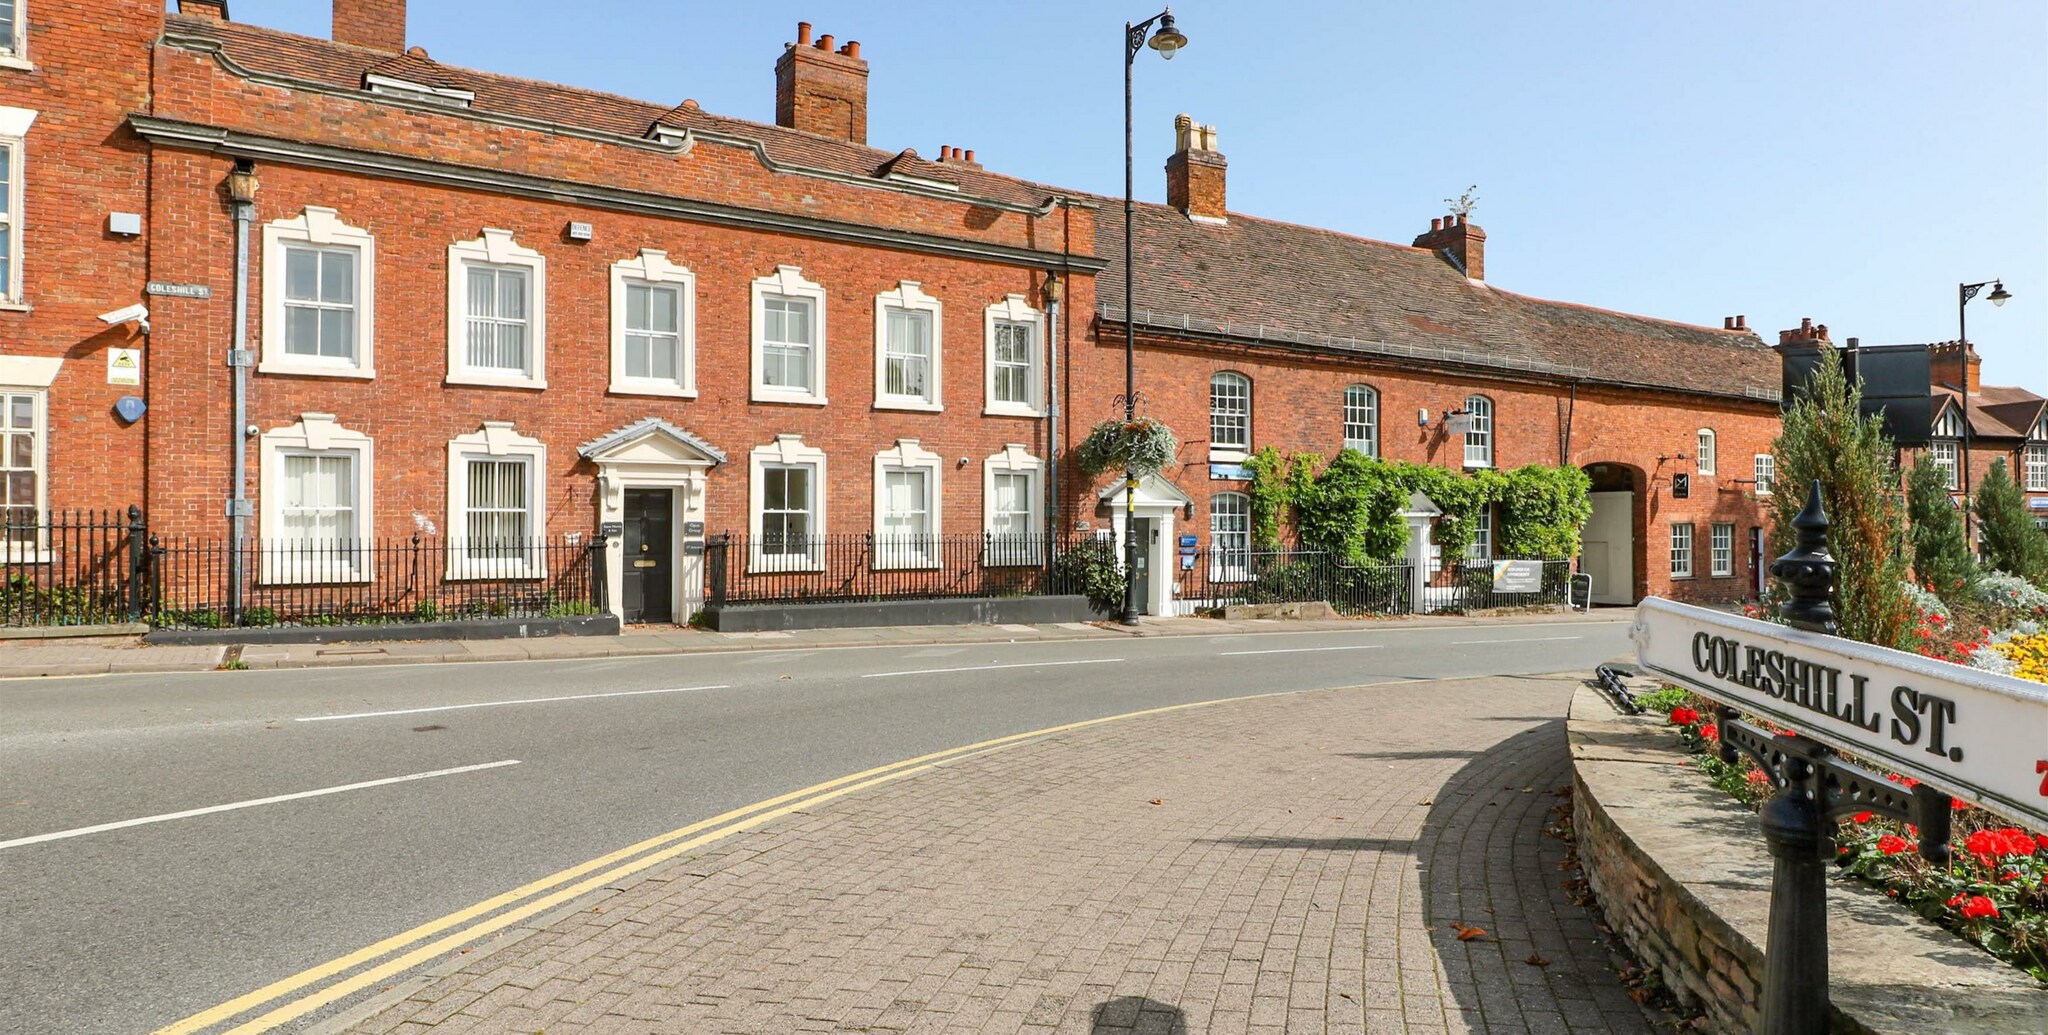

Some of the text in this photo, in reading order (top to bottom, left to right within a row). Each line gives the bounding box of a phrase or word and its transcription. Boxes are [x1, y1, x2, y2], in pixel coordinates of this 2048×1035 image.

[150, 284, 195, 295] COLESHILL
[1692, 631, 1964, 763] COLESHILL ST.
